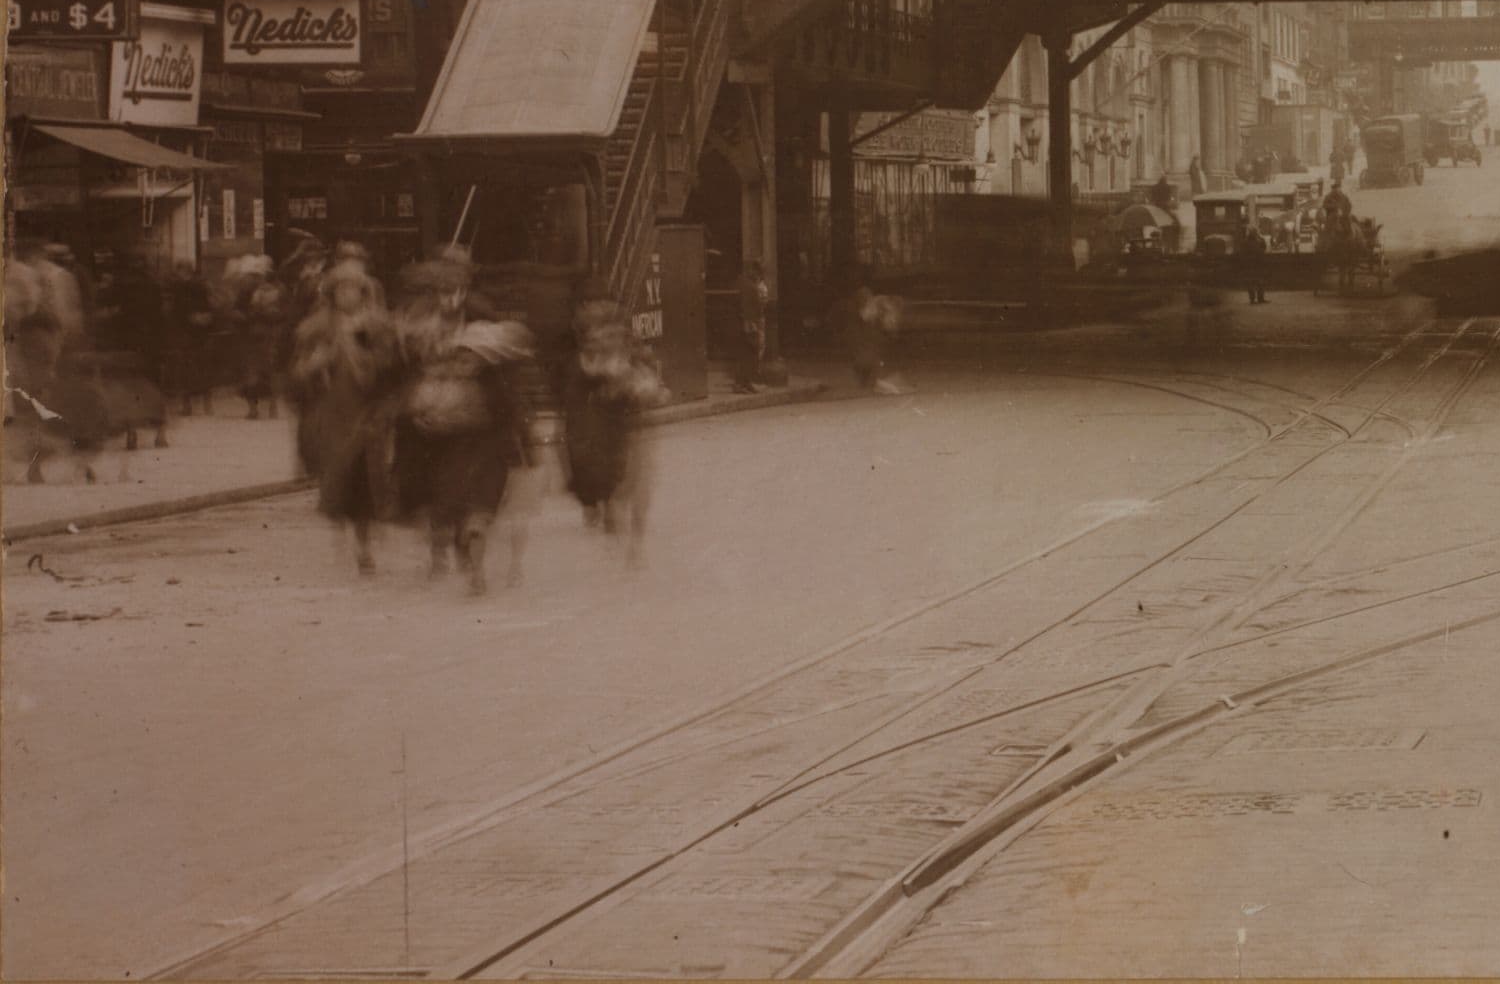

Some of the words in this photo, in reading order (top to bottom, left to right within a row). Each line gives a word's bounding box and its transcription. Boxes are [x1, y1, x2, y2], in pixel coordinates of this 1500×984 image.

[31, 10, 60, 23] AND
[69, 2, 116, 30] $4
[227, 2, 357, 54] Nedick's
[124, 42, 195, 104] Nedick's
